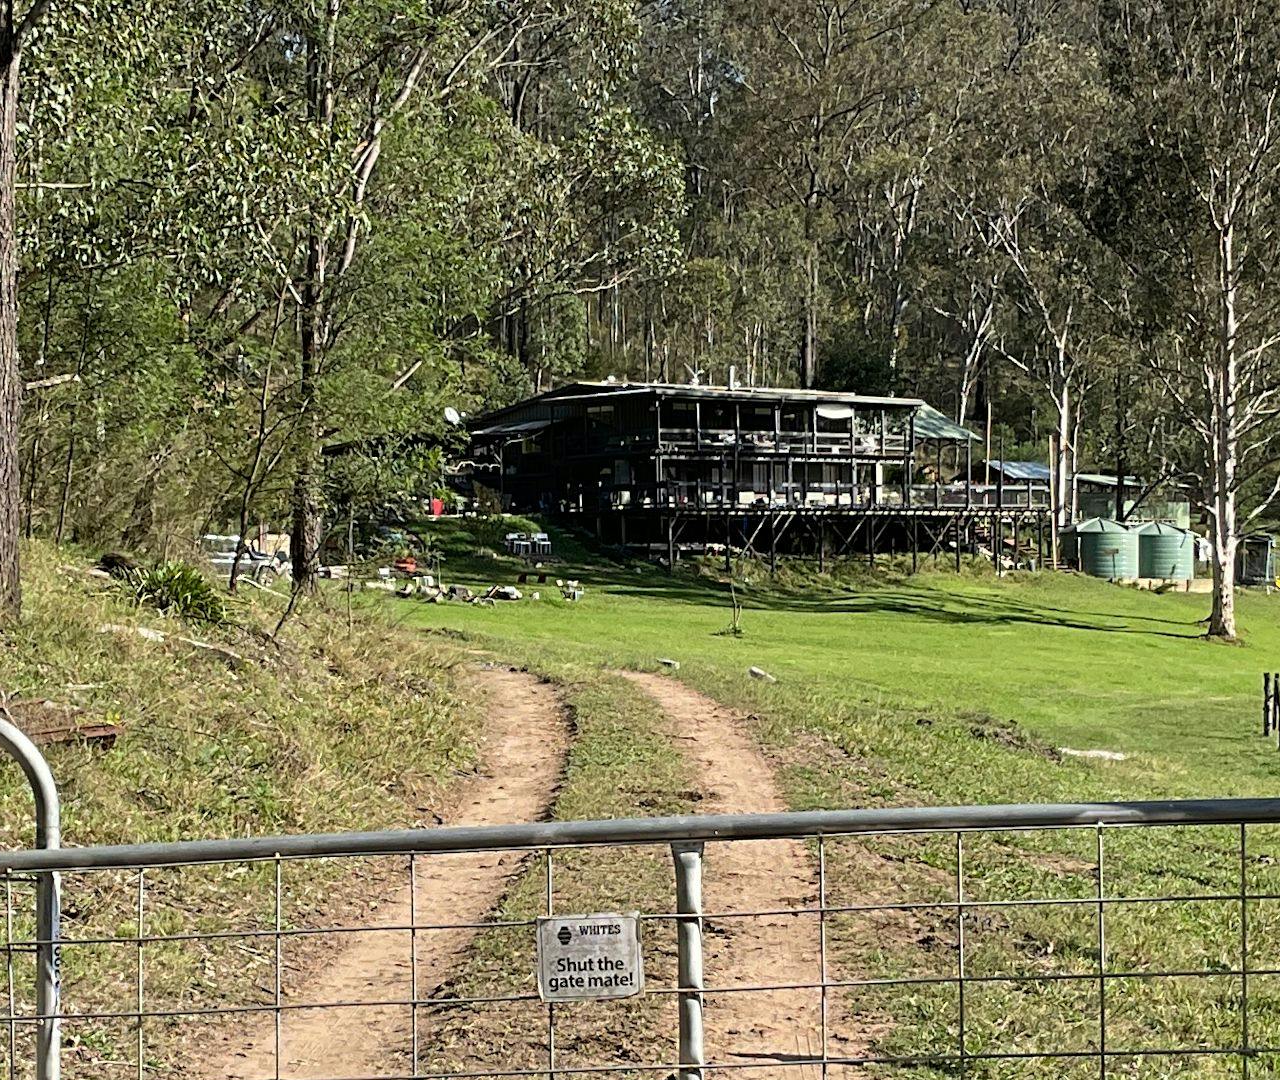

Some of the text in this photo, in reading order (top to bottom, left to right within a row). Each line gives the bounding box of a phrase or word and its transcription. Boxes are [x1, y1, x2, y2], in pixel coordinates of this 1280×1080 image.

[579, 924, 621, 936] WHITES
[557, 956, 624, 972] Shut the
[548, 972, 634, 992] gate mate!
